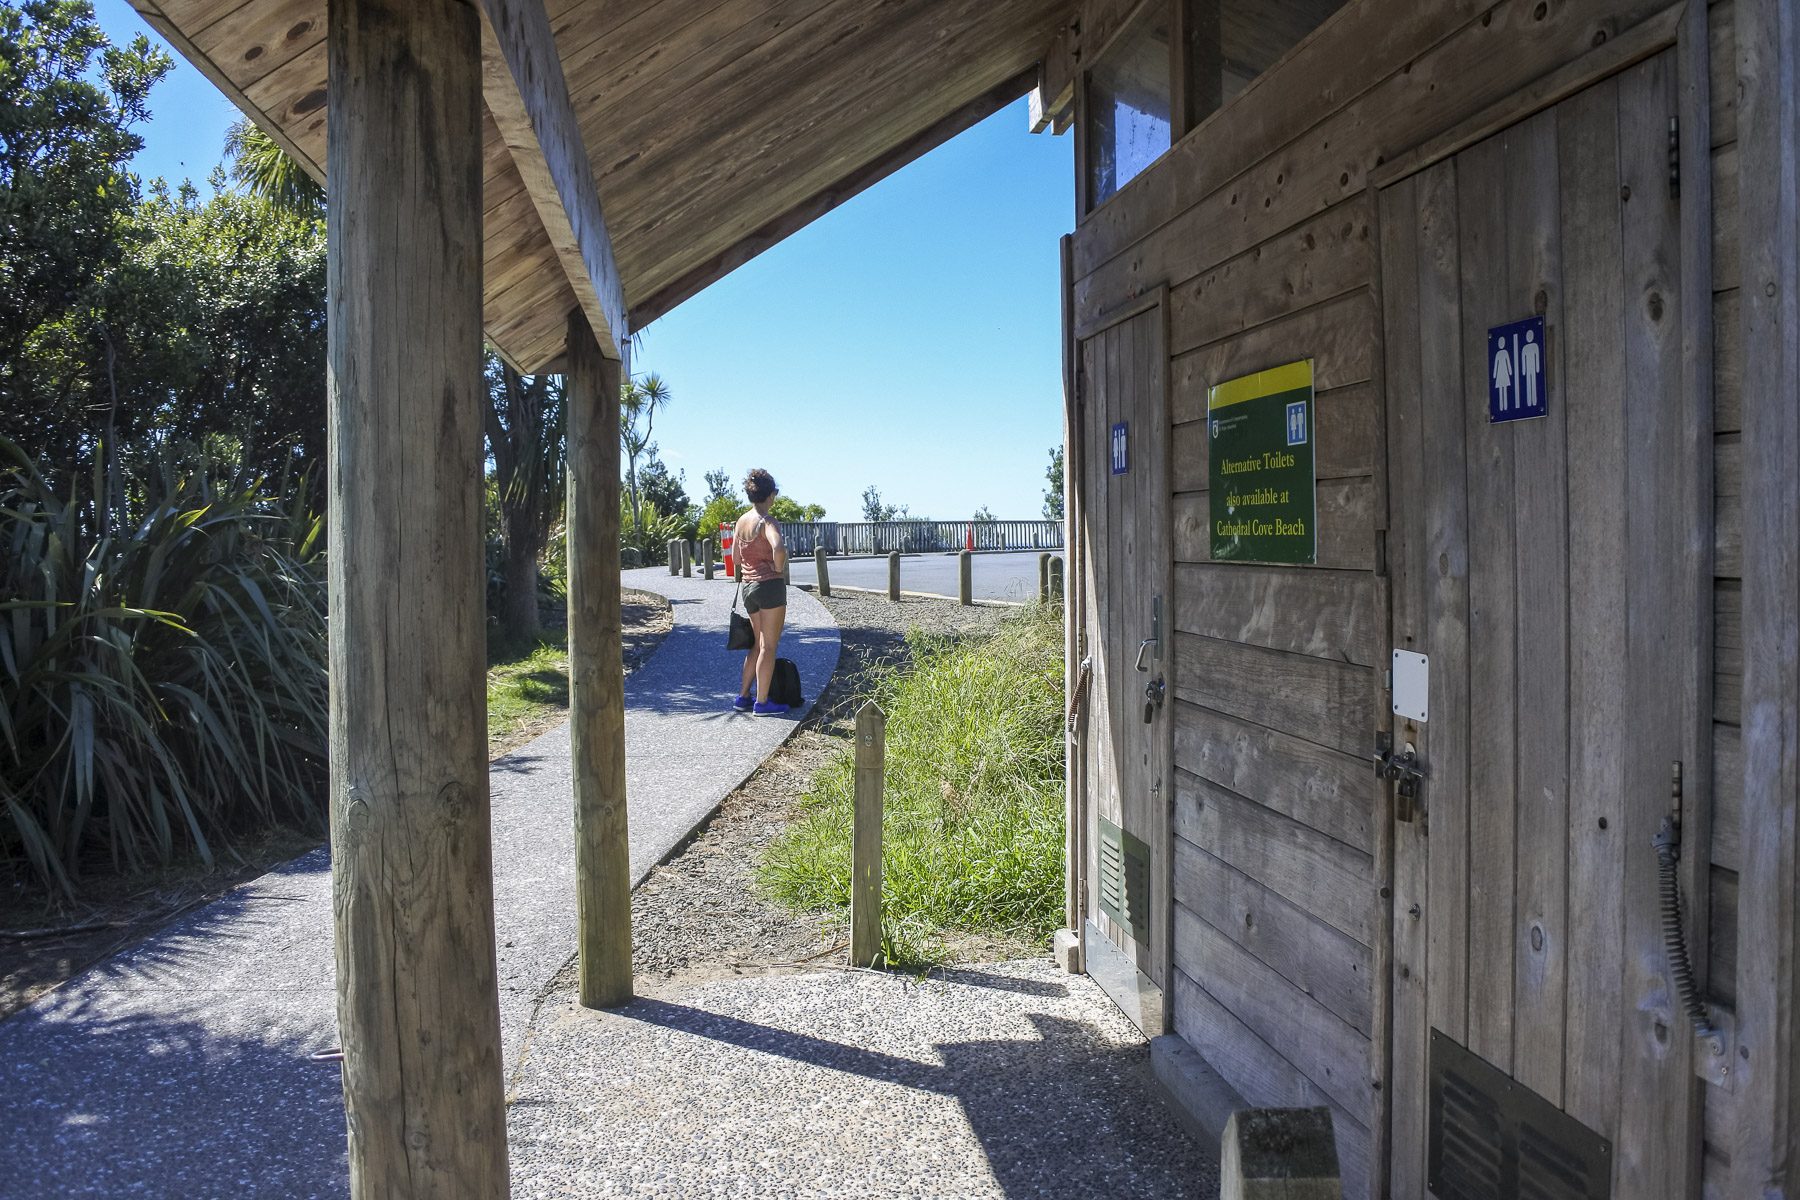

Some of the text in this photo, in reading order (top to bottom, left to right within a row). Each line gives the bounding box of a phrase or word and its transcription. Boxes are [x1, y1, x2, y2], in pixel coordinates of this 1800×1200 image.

[1220, 451, 1295, 475] Alternative Toilets
[1226, 488, 1289, 507] also available at
[1216, 518, 1305, 536] Cathedral Cove Beach
